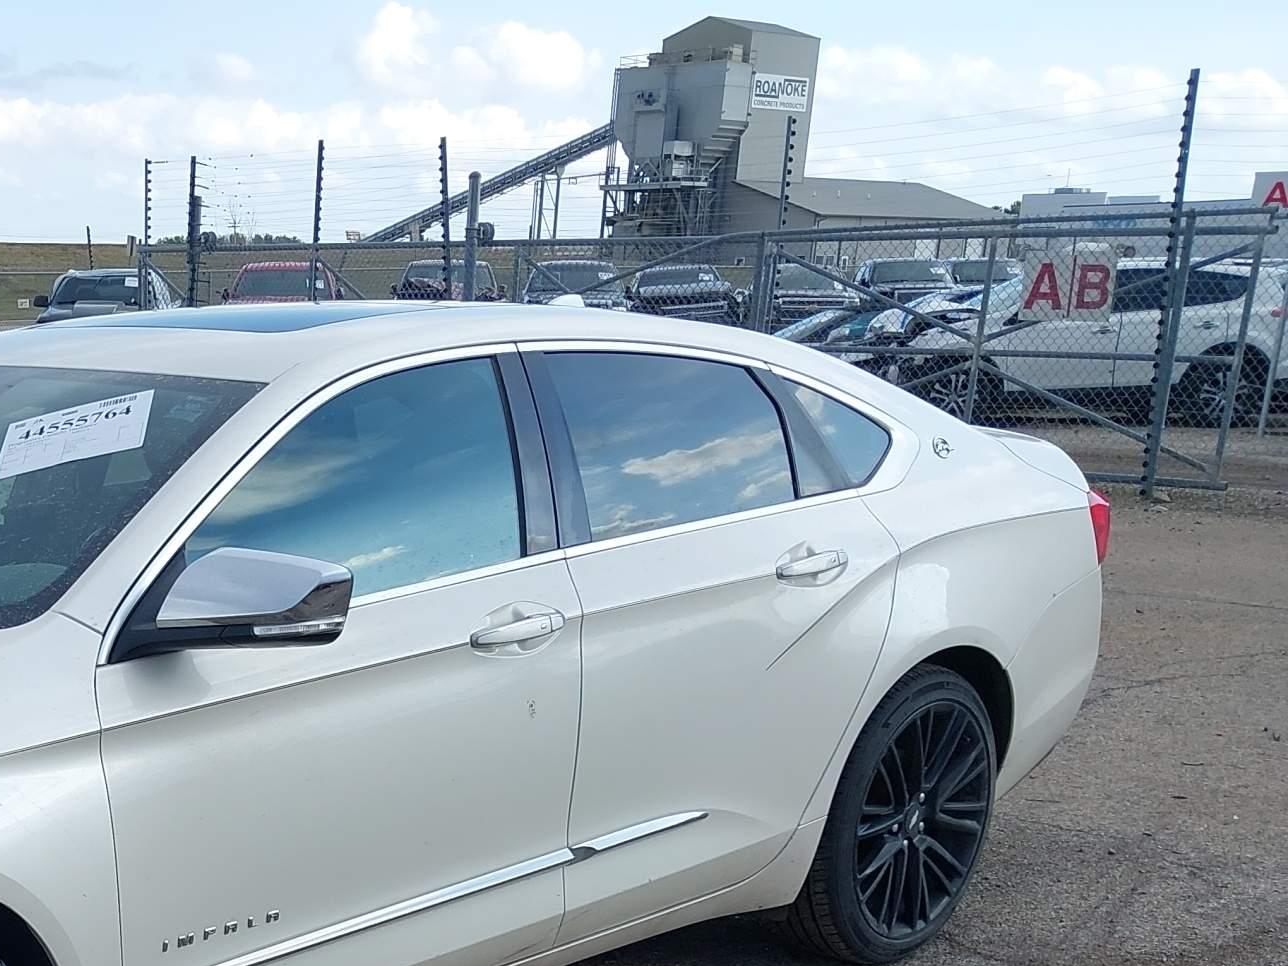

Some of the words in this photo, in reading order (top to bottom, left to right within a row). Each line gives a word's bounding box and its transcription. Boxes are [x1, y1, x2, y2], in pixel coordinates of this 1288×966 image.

[755, 79, 807, 98] ROANOKE
[18, 405, 132, 440] 44555764
[162, 909, 280, 952] IMPALA
